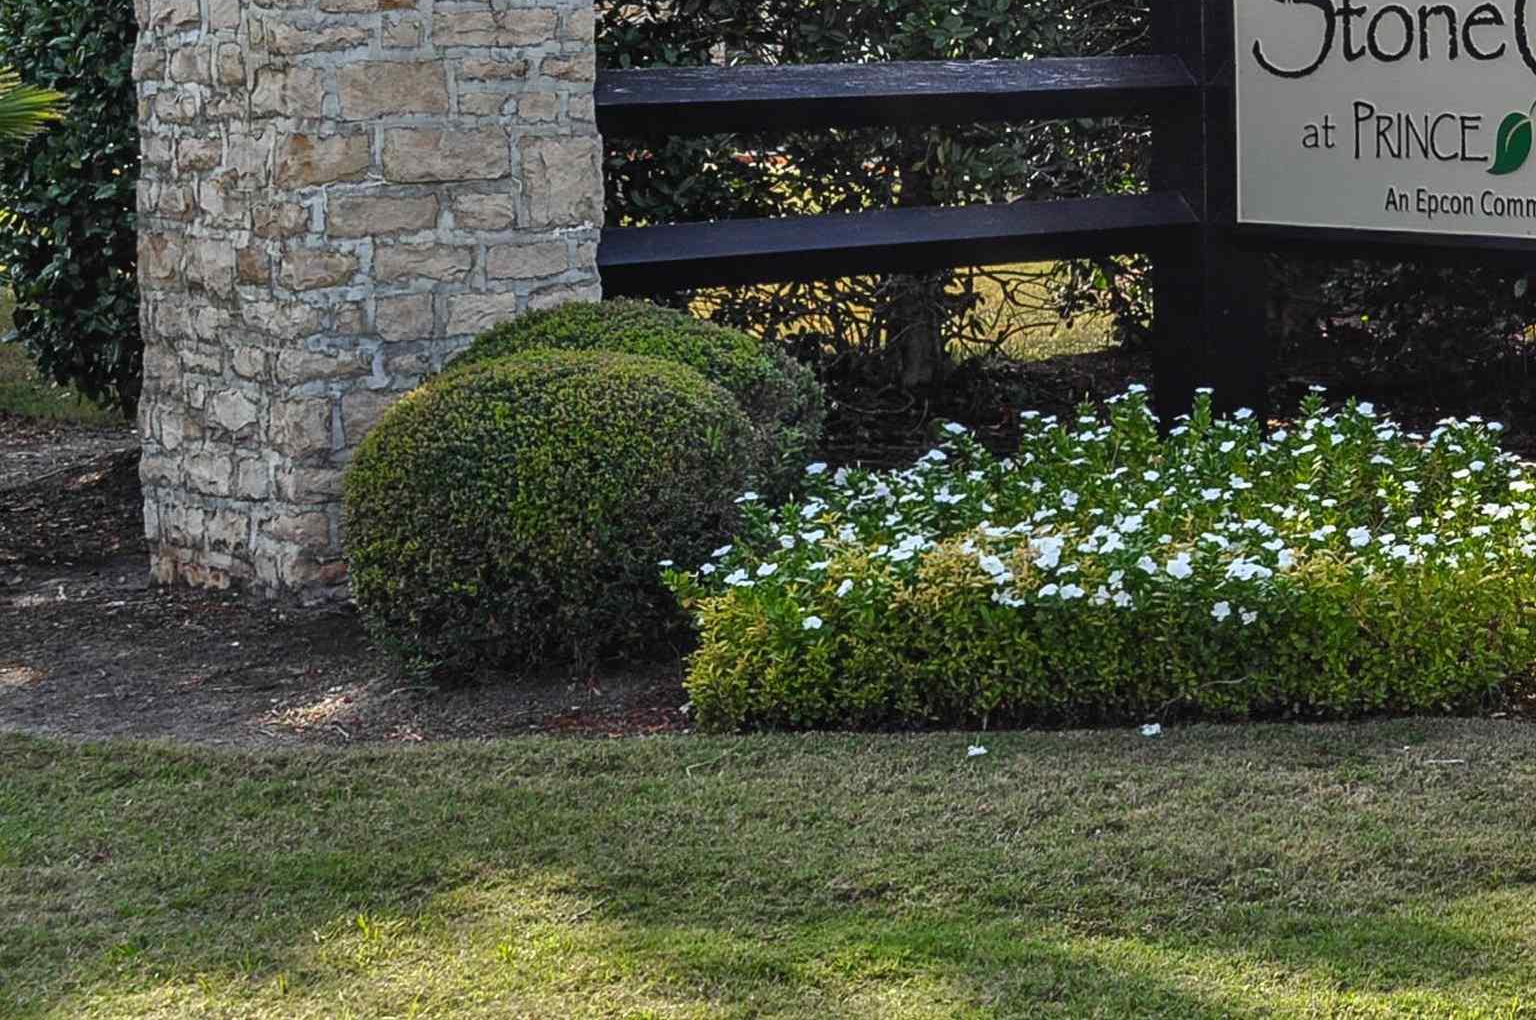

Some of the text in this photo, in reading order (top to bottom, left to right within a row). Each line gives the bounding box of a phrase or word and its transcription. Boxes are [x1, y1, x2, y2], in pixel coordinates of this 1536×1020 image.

[1301, 114, 1337, 150] at
[1352, 100, 1489, 163] PRINCE
[1384, 187, 1410, 214] An
[1416, 187, 1475, 221] Epcon
